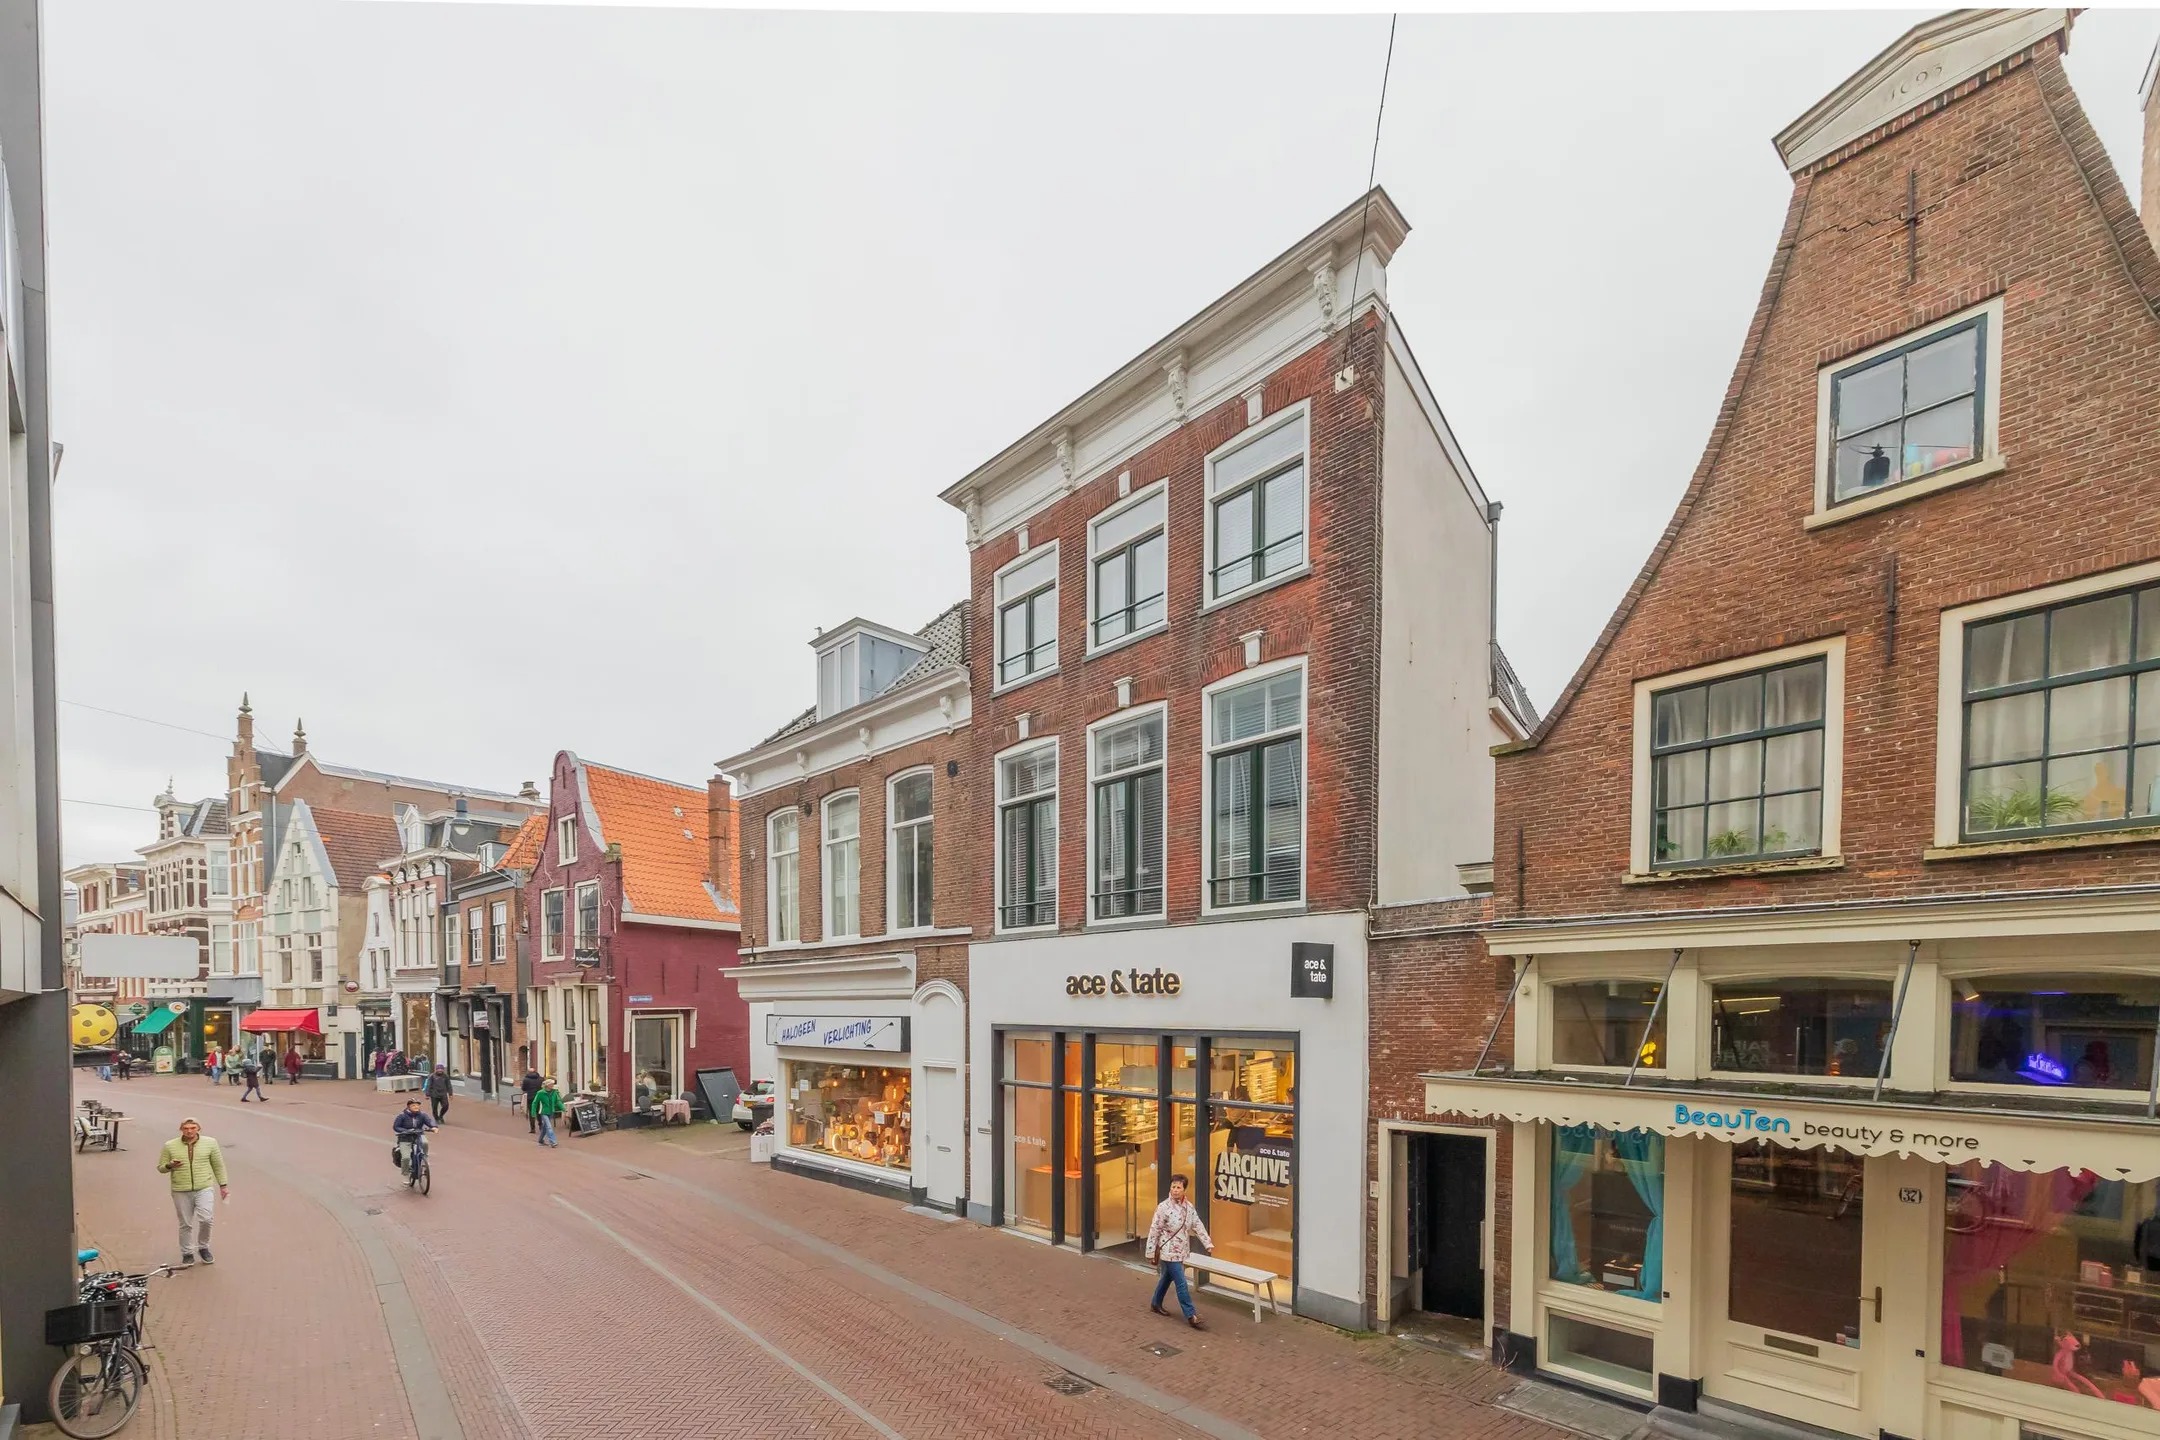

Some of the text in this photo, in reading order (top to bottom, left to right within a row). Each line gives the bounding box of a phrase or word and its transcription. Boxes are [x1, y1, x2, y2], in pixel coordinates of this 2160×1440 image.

[1304, 959, 1326, 970] ace &
[1310, 970, 1327, 983] tate
[1066, 967, 1181, 995] ace & tate
[781, 1018, 872, 1046] HALOGEEN VERLICHTING
[1674, 1103, 1980, 1150] BeauTen beauty & more
[1277, 1149, 1290, 1158] tate
[1217, 1151, 1290, 1185] ARCHIVE
[1217, 1174, 1256, 1203] SALE
[1902, 1189, 1918, 1202] 37
